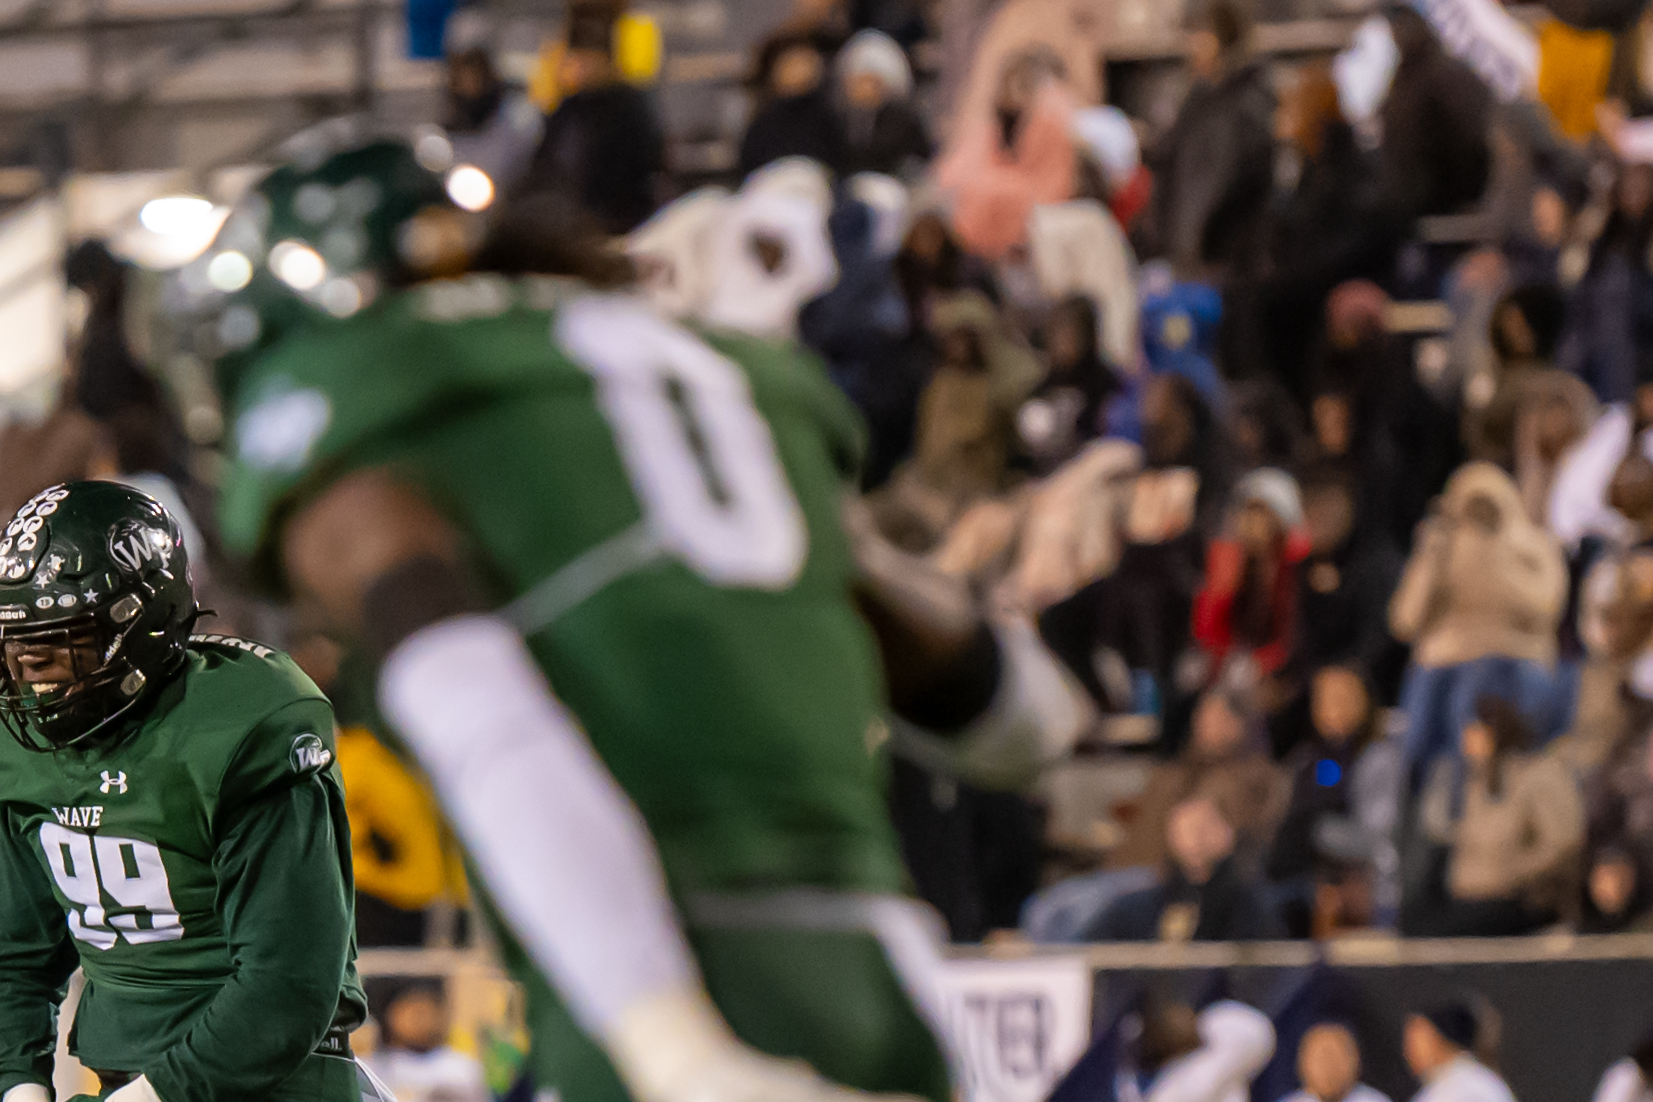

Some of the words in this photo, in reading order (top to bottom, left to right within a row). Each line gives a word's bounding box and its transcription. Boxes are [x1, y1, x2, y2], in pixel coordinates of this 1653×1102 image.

[554, 300, 806, 588] 0
[51, 806, 104, 827] WAVE
[39, 822, 185, 950] 99
